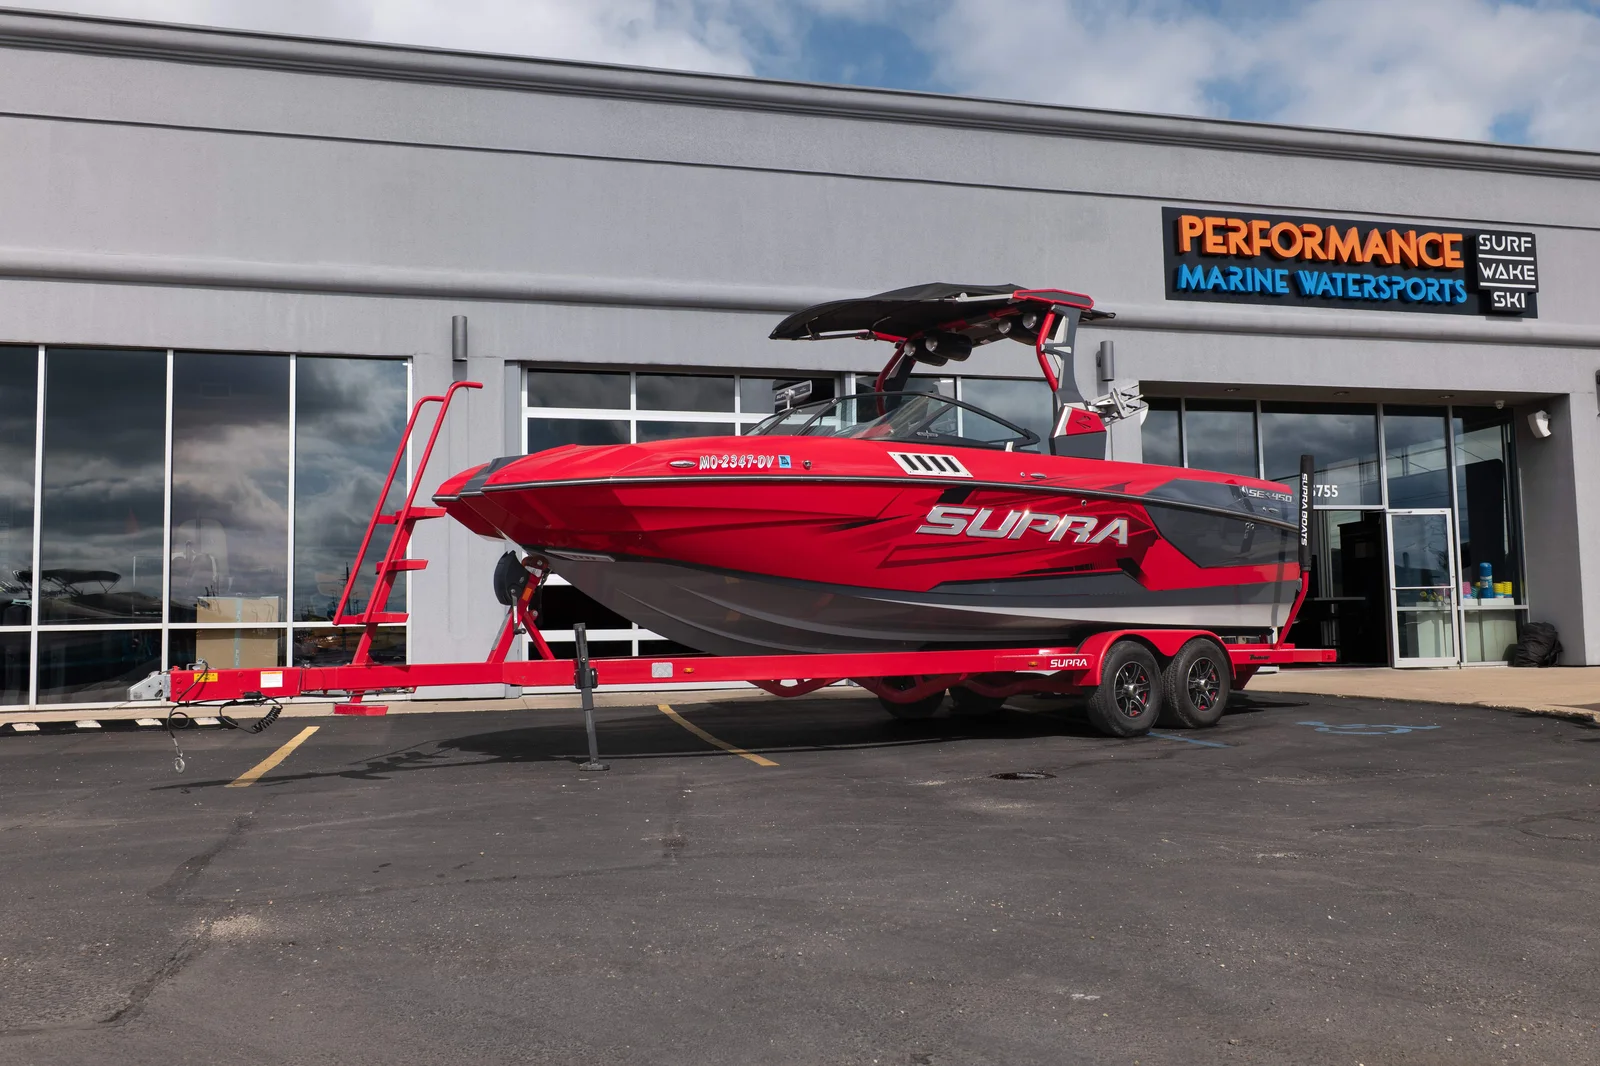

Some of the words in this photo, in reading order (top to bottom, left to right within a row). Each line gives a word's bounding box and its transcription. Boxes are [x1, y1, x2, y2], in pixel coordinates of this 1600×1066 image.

[1178, 215, 1464, 268] PERFORMANCE
[1478, 234, 1532, 252] SURF
[1478, 262, 1536, 281] WAKE
[1177, 264, 1289, 294] MARINE
[1295, 270, 1467, 303] WATERSPORTS
[1493, 291, 1526, 308] SKI
[1248, 489, 1265, 498] SE
[915, 505, 1129, 546] SUPRA
[1050, 658, 1088, 668] SUPRA
